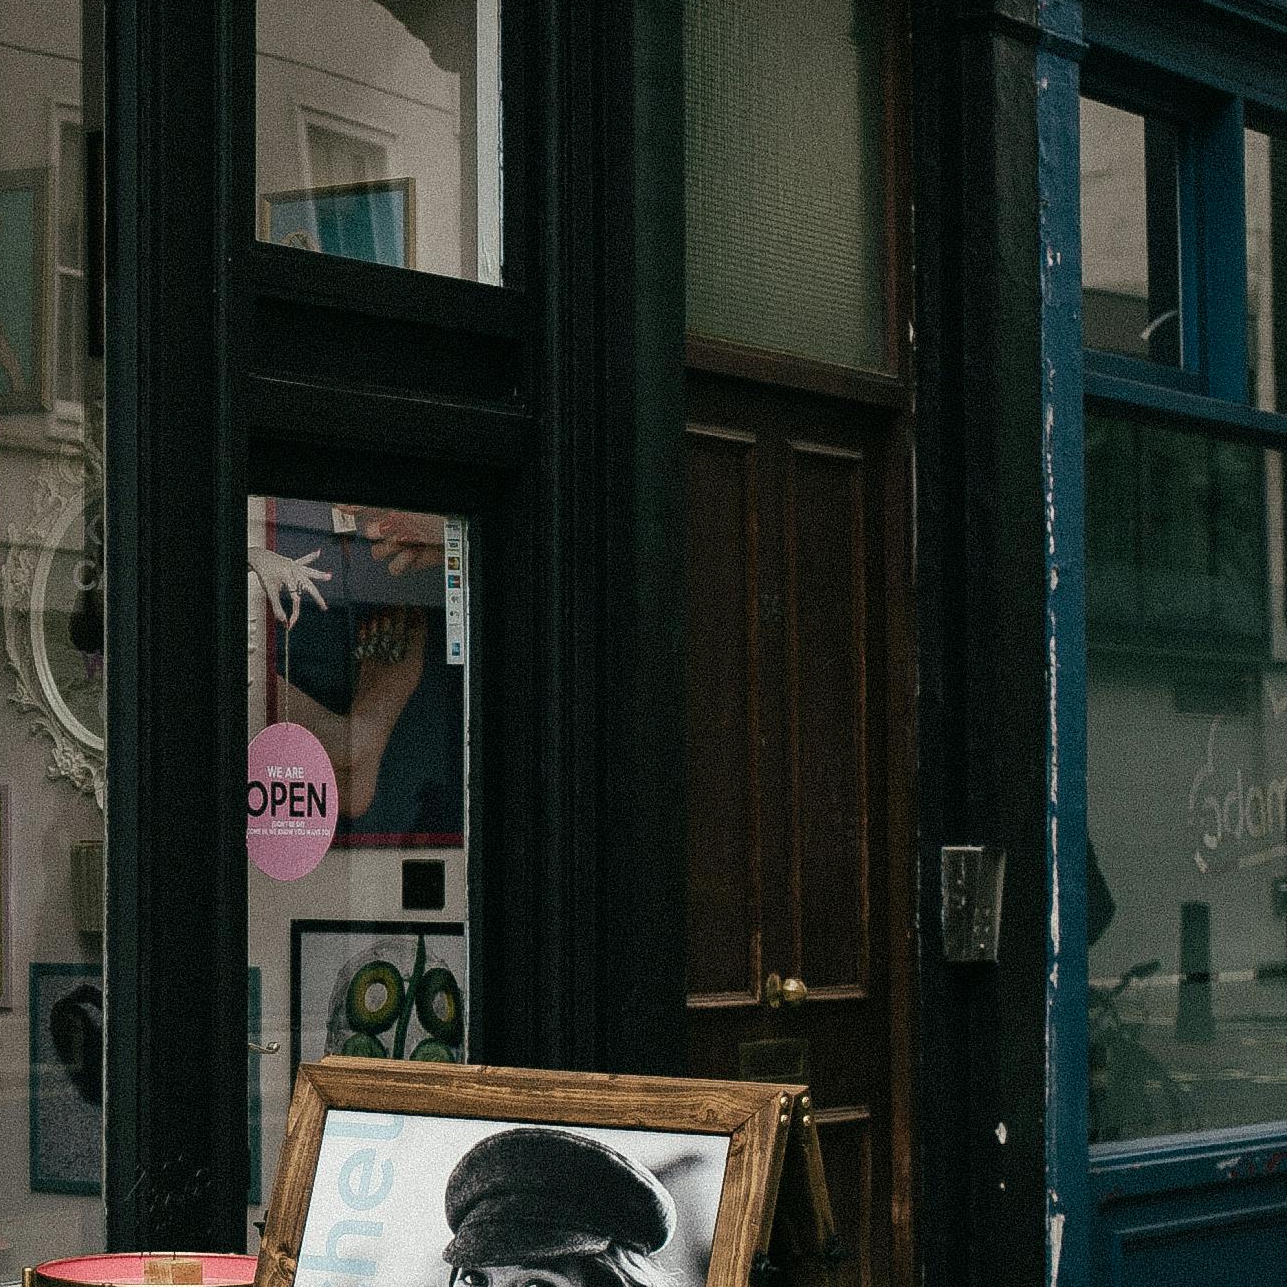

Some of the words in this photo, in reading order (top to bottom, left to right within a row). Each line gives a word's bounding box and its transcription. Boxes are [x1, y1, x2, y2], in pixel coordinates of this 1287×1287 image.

[266, 765, 283, 778] WE
[285, 766, 305, 779] ARE
[246, 780, 327, 818] OPEN
